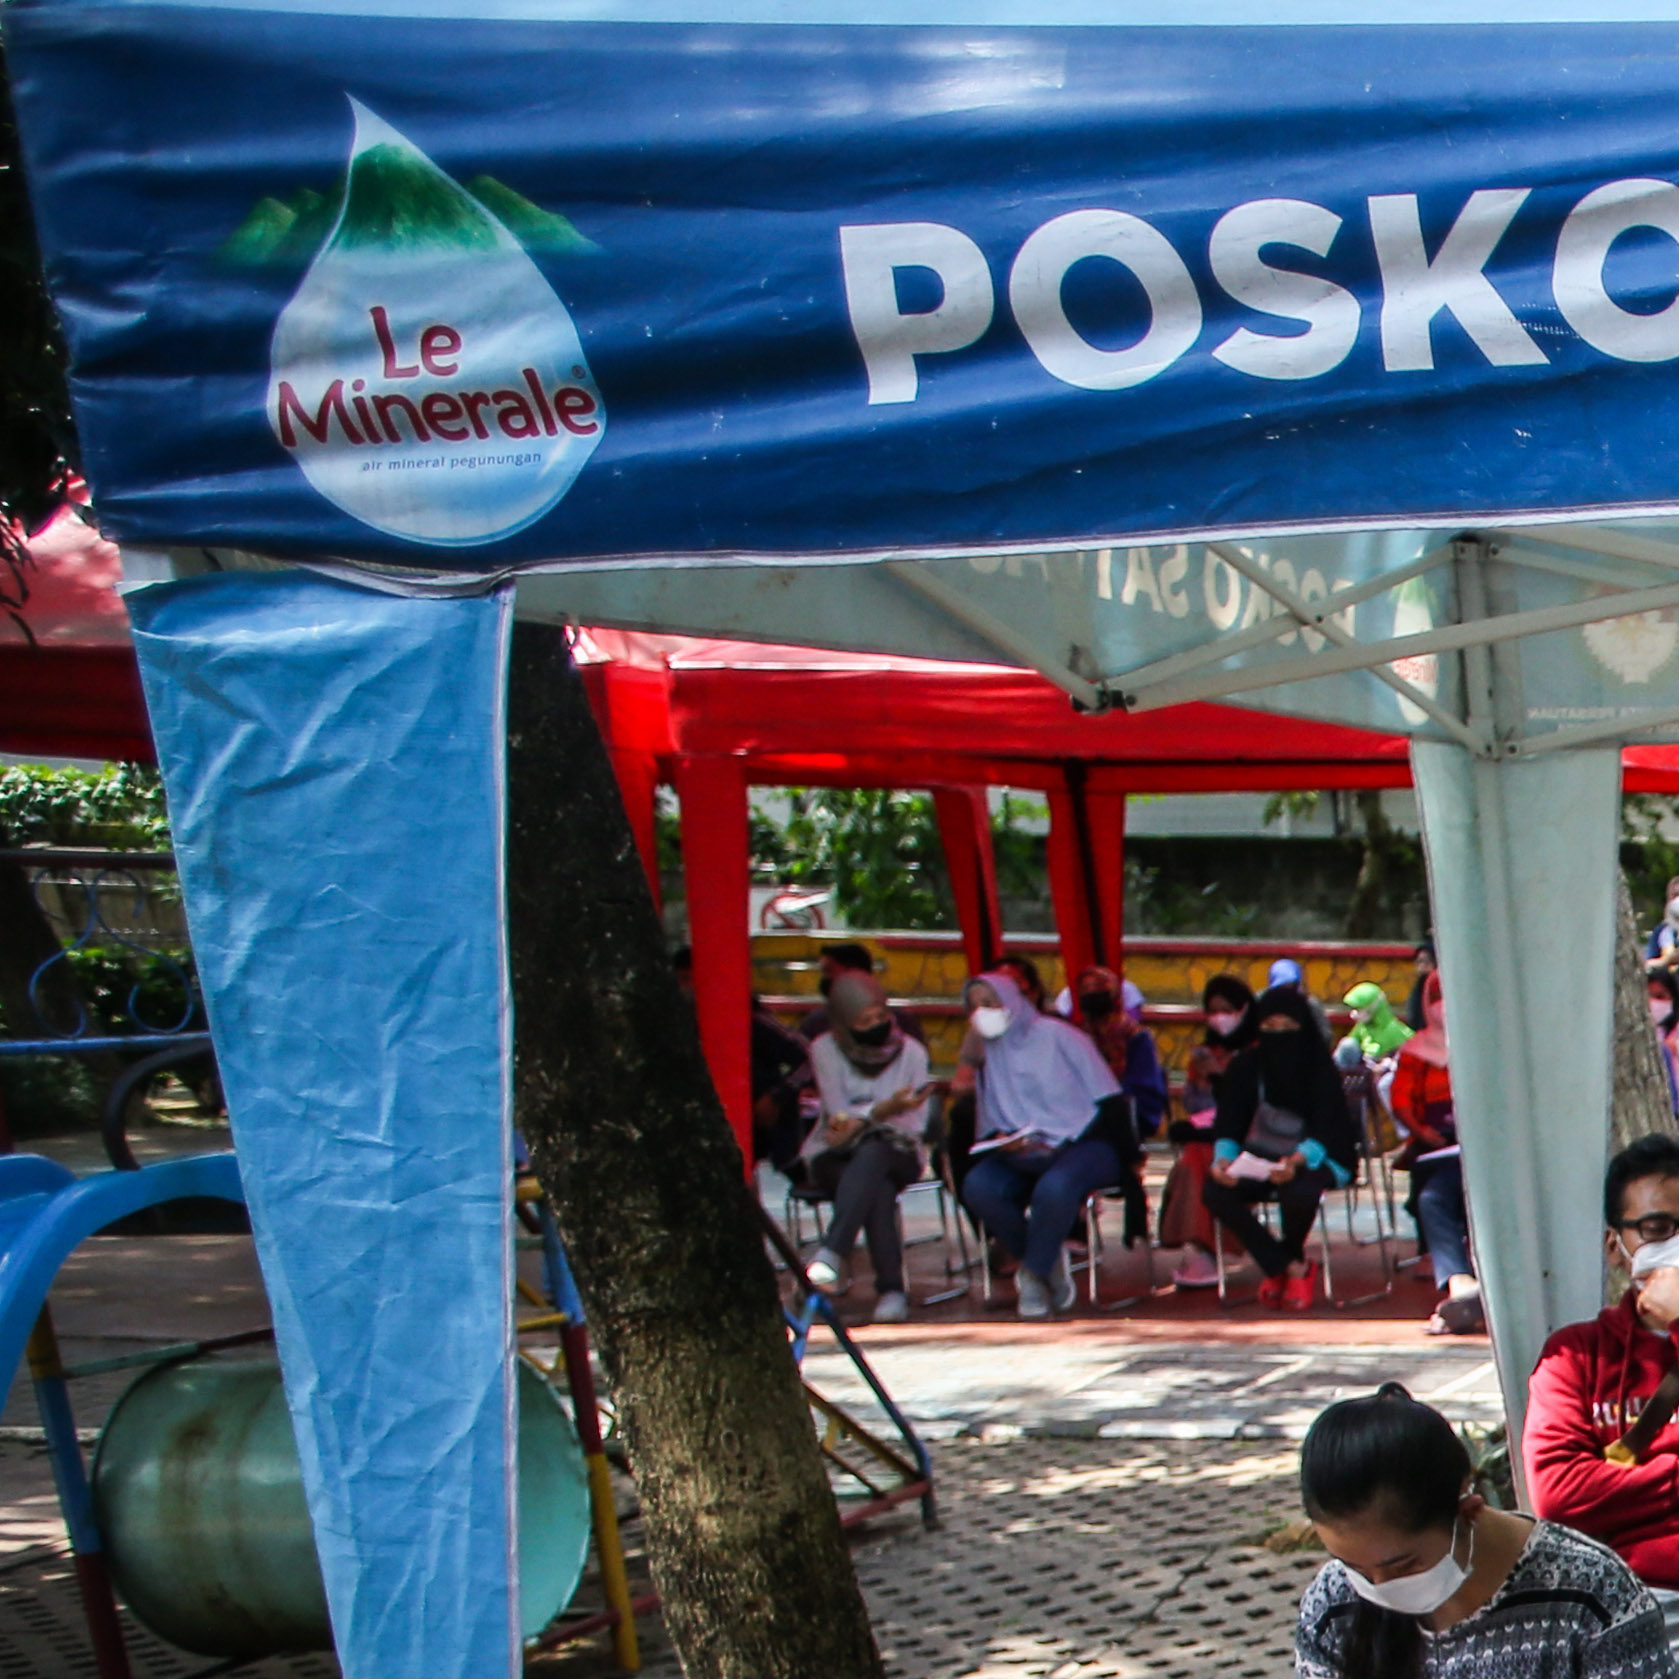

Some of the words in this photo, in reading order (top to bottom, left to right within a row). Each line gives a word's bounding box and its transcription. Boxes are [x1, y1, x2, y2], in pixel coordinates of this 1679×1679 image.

[369, 306, 462, 379] Le
[278, 368, 598, 447] Minerale
[362, 460, 383, 472] air
[388, 457, 445, 470] mineral
[450, 452, 541, 469] pegunungan
